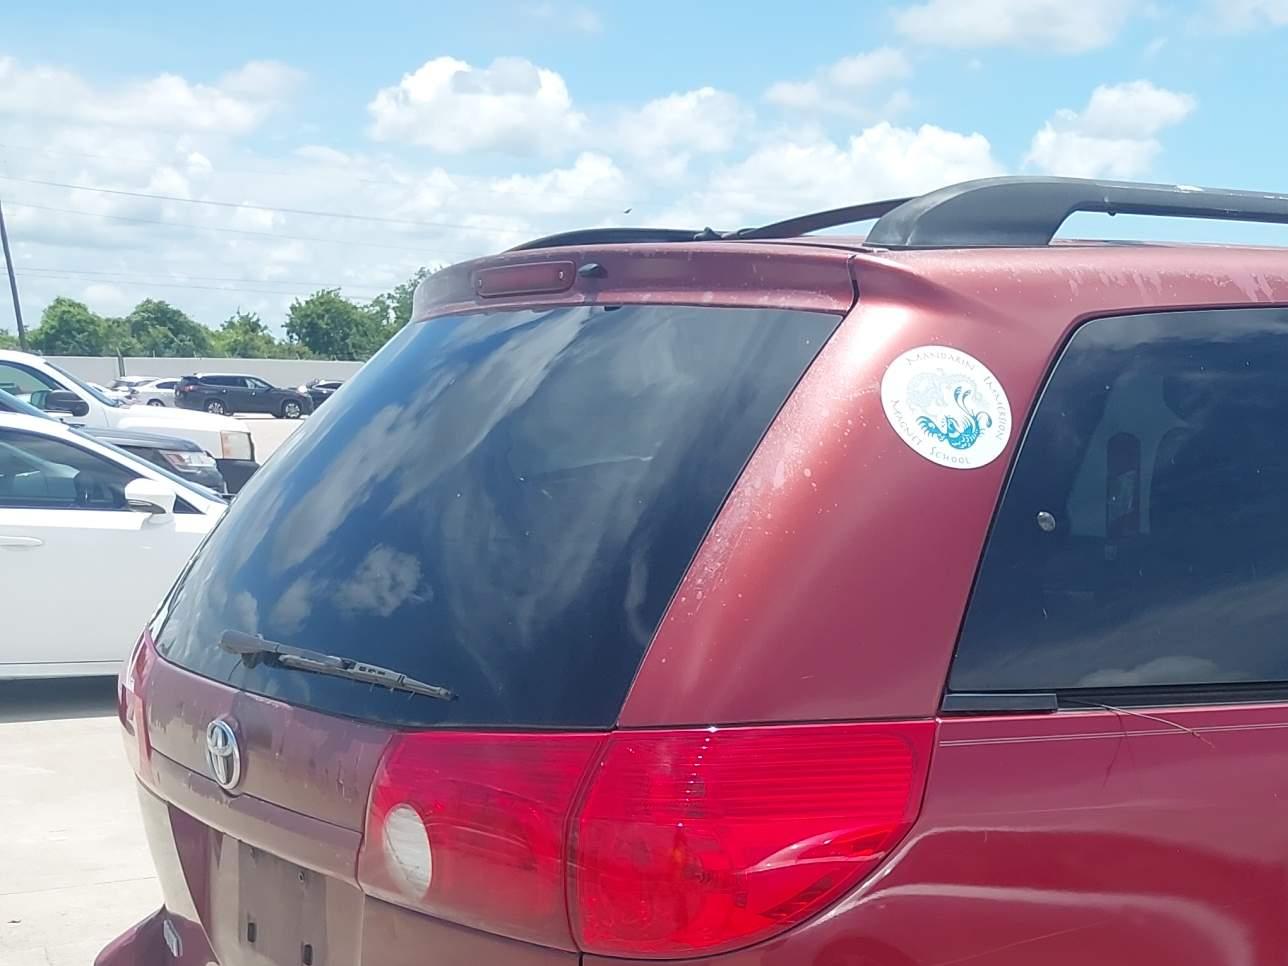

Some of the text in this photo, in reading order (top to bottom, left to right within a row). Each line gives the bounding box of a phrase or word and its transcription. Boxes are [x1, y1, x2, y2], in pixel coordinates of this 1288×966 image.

[905, 351, 977, 371] MANDARIN
[890, 399, 972, 464] MAGNET SCHOOL
